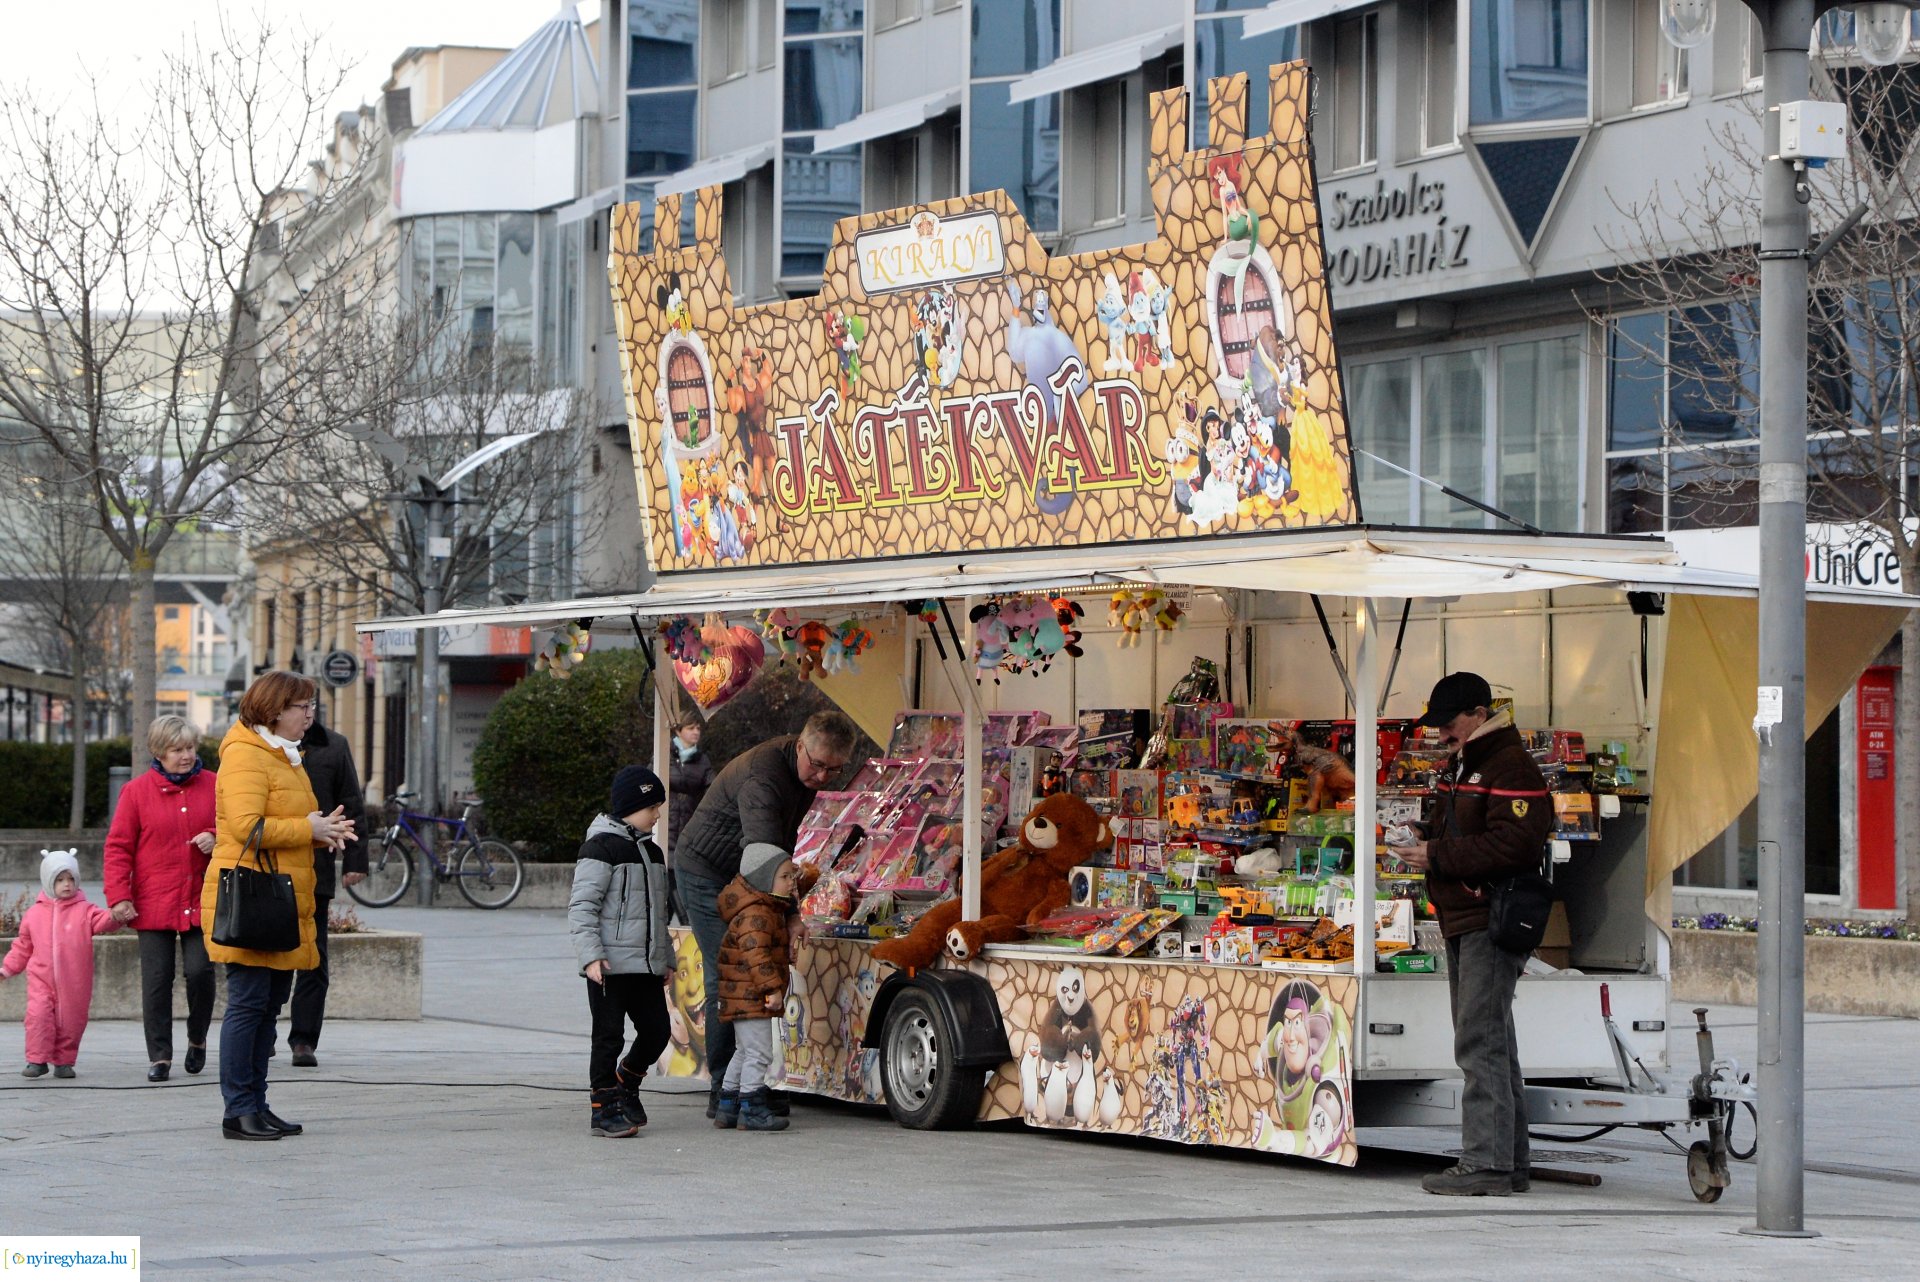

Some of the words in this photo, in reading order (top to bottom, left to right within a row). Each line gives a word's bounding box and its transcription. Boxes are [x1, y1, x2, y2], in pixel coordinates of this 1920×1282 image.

[1330, 171, 1445, 231] Szabolcs
[866, 224, 995, 285] KIRÁLYI
[772, 355, 1166, 517] JÁTÉKVÁR
[1814, 540, 1900, 586] UniCre
